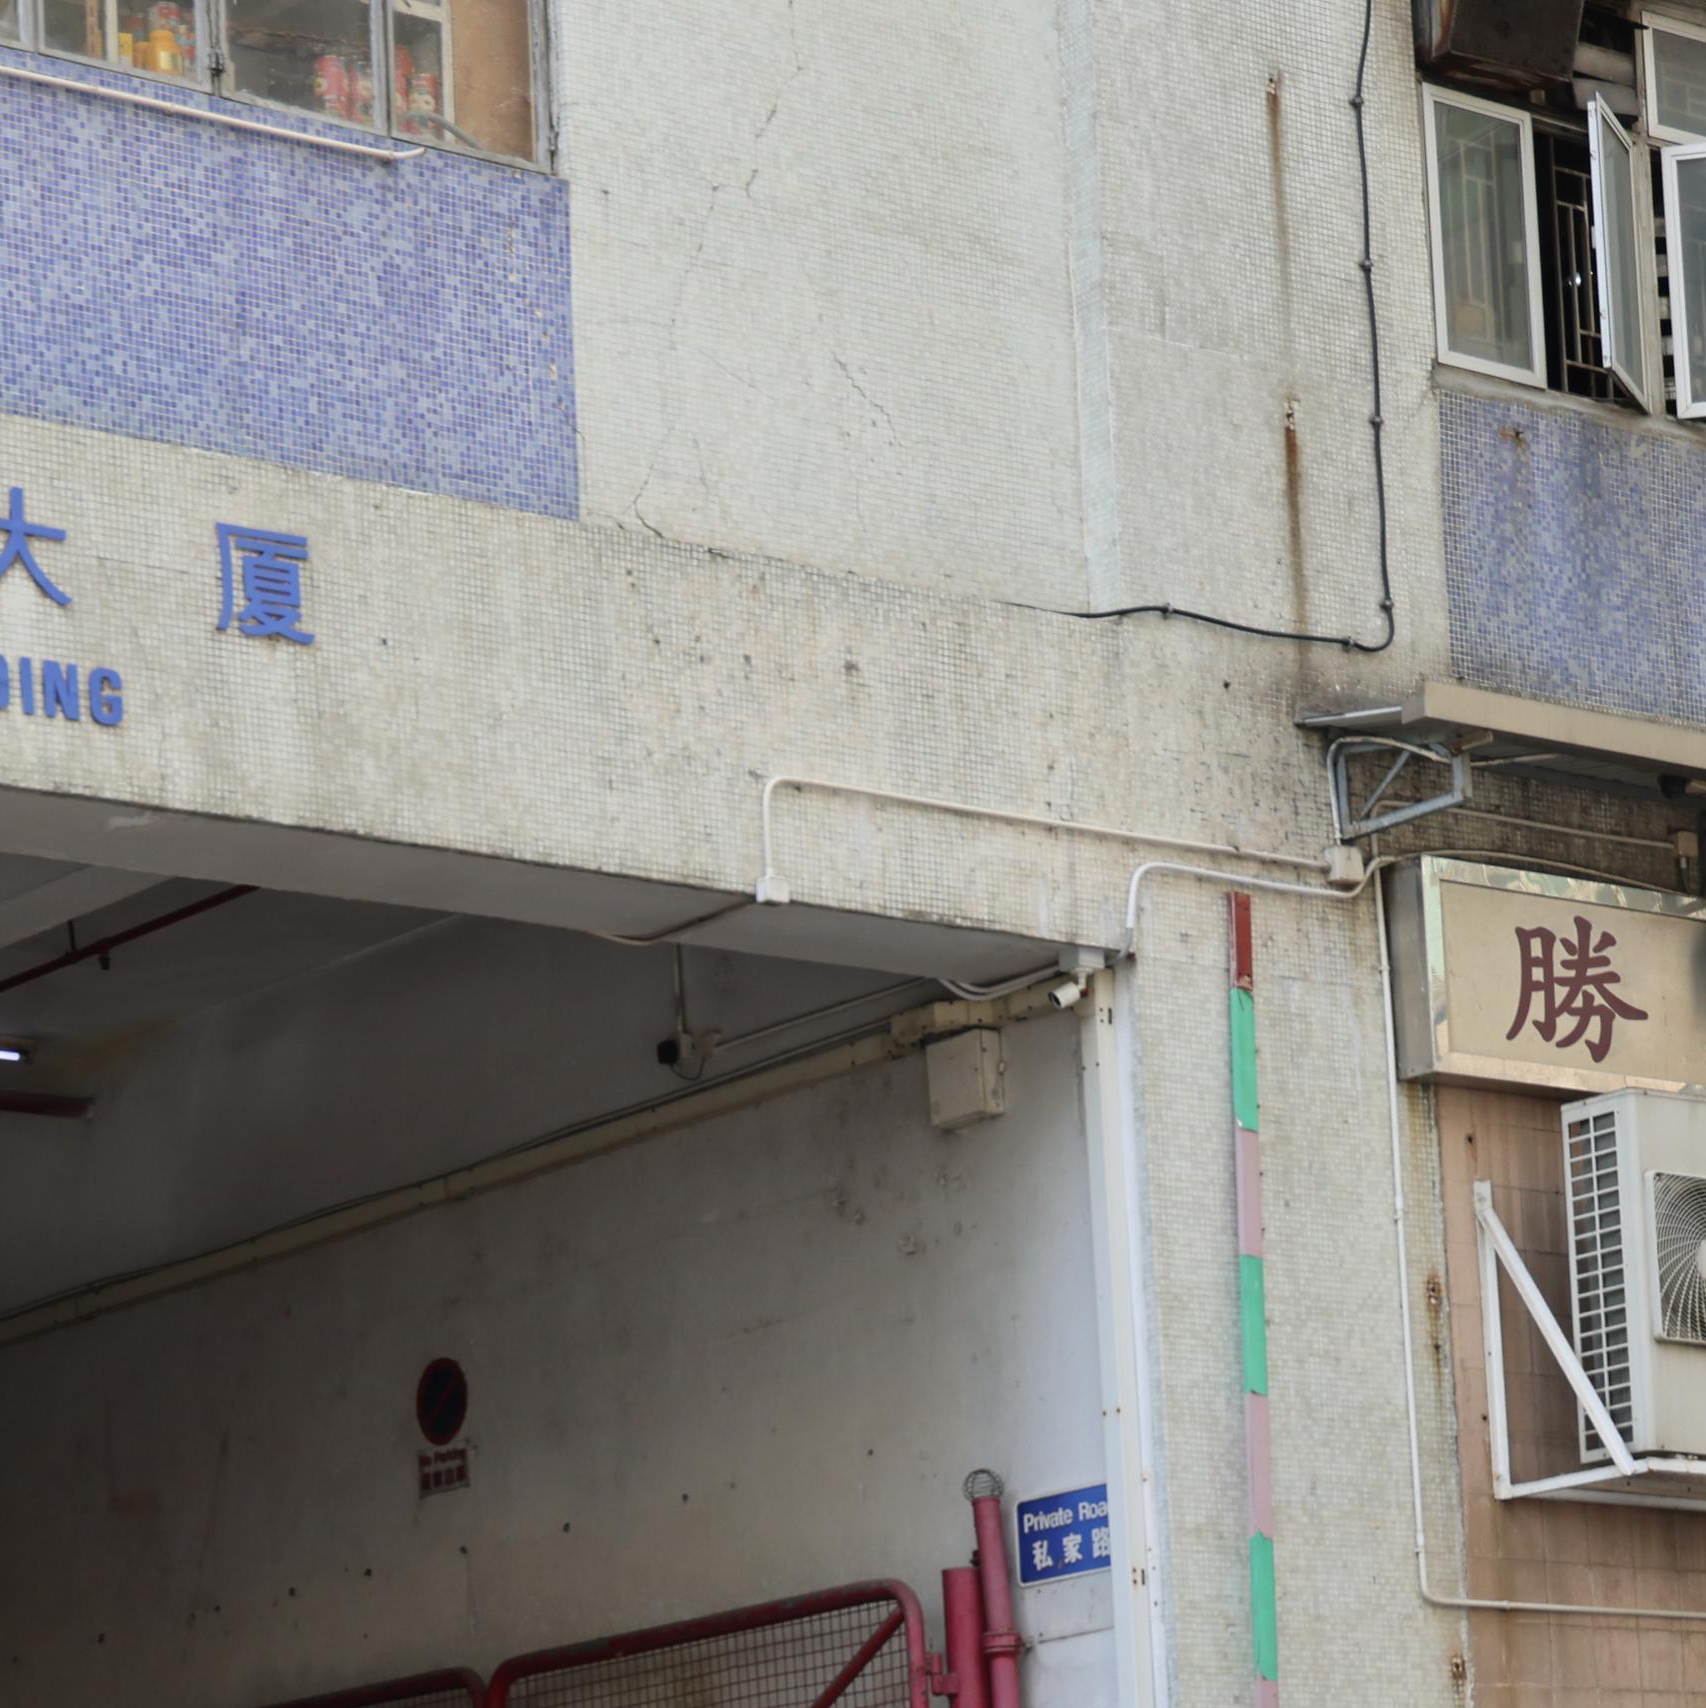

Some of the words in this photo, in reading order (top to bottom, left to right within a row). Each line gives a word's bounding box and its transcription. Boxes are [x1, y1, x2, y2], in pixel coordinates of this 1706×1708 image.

[1023, 1507, 1073, 1534] Private
[1078, 1500, 1109, 1522] Roa
[1032, 1527, 1111, 1571] 私家路
